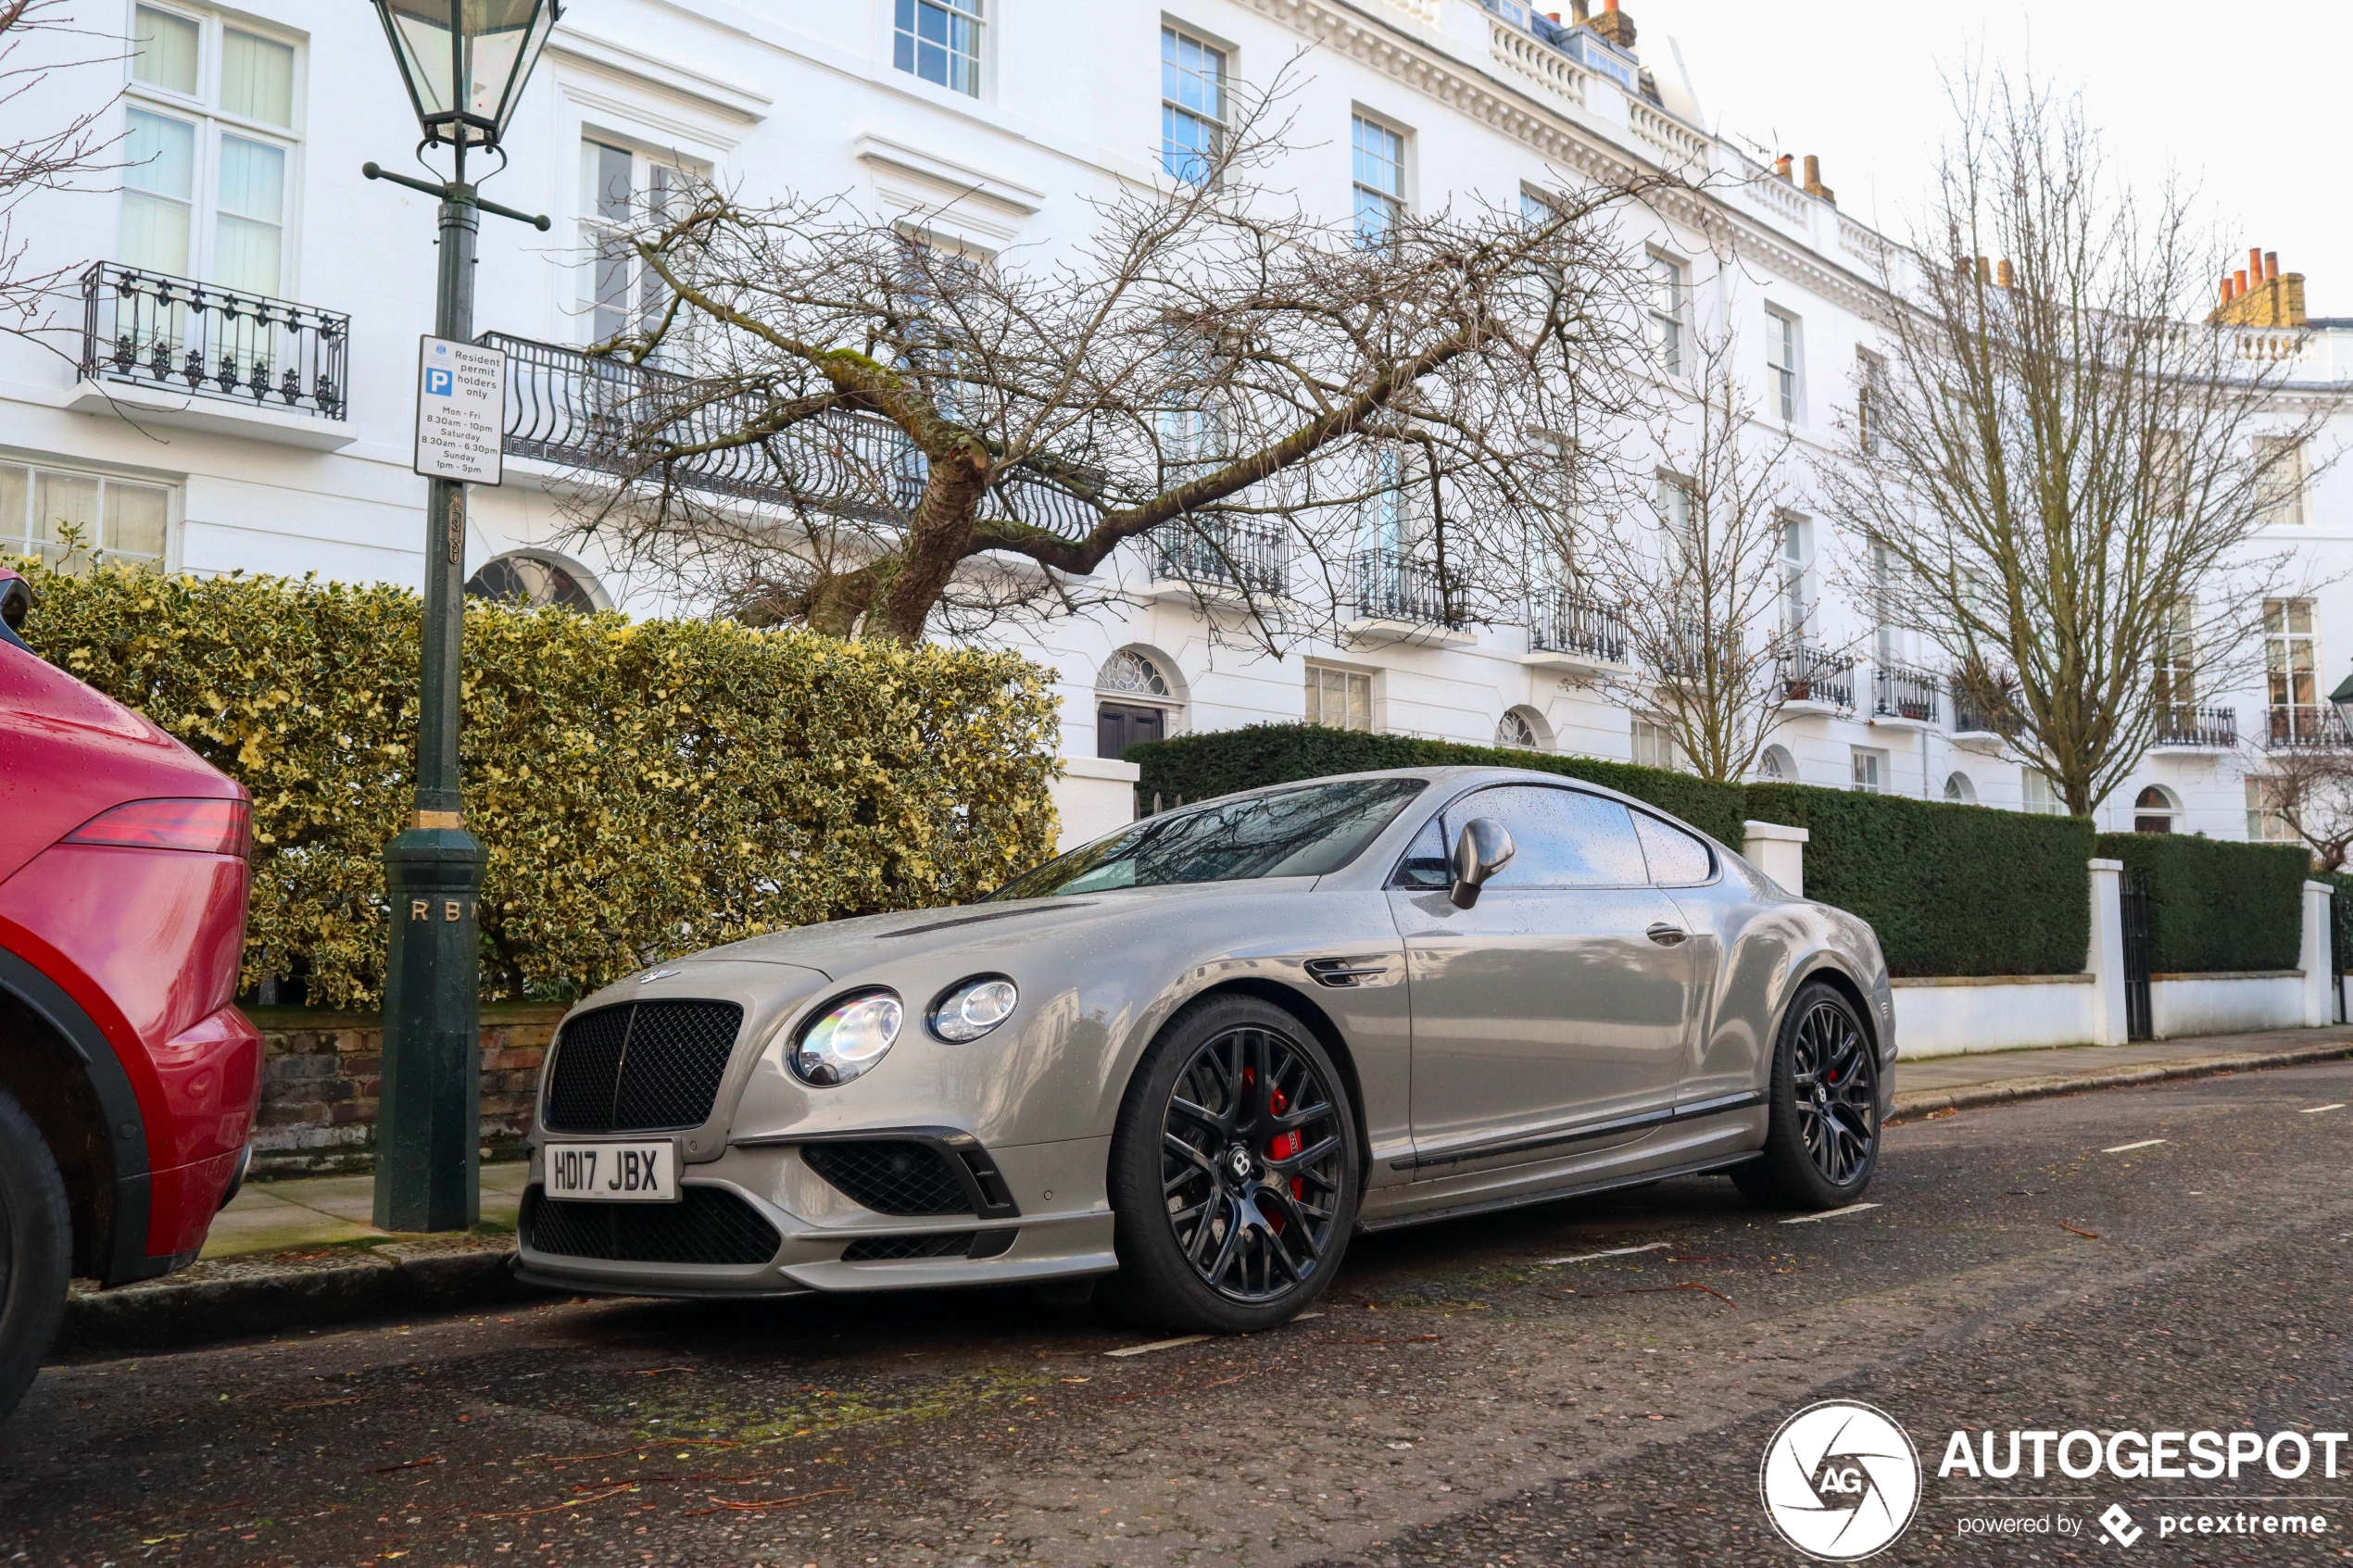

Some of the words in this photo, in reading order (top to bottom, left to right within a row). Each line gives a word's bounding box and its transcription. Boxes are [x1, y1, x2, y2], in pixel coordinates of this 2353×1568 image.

[455, 350, 500, 367] Resident
[460, 365, 495, 377] permit
[431, 370, 448, 392] P
[458, 374, 497, 389] holders
[466, 389, 488, 400] only
[442, 407, 461, 417] Mon
[469, 411, 481, 420] Fri
[427, 415, 461, 427] 8.30am
[470, 422, 493, 433] 10pm
[440, 428, 481, 443] Saturday
[422, 435, 456, 448] 8.30am
[464, 443, 498, 455] 6.30pm
[443, 450, 475, 463] Sunday
[436, 460, 454, 470] 1pm
[461, 464, 482, 473] 5pm
[412, 901, 429, 922] R
[446, 901, 460, 922] B
[555, 1151, 597, 1190] HD17
[608, 1150, 658, 1191] JBX
